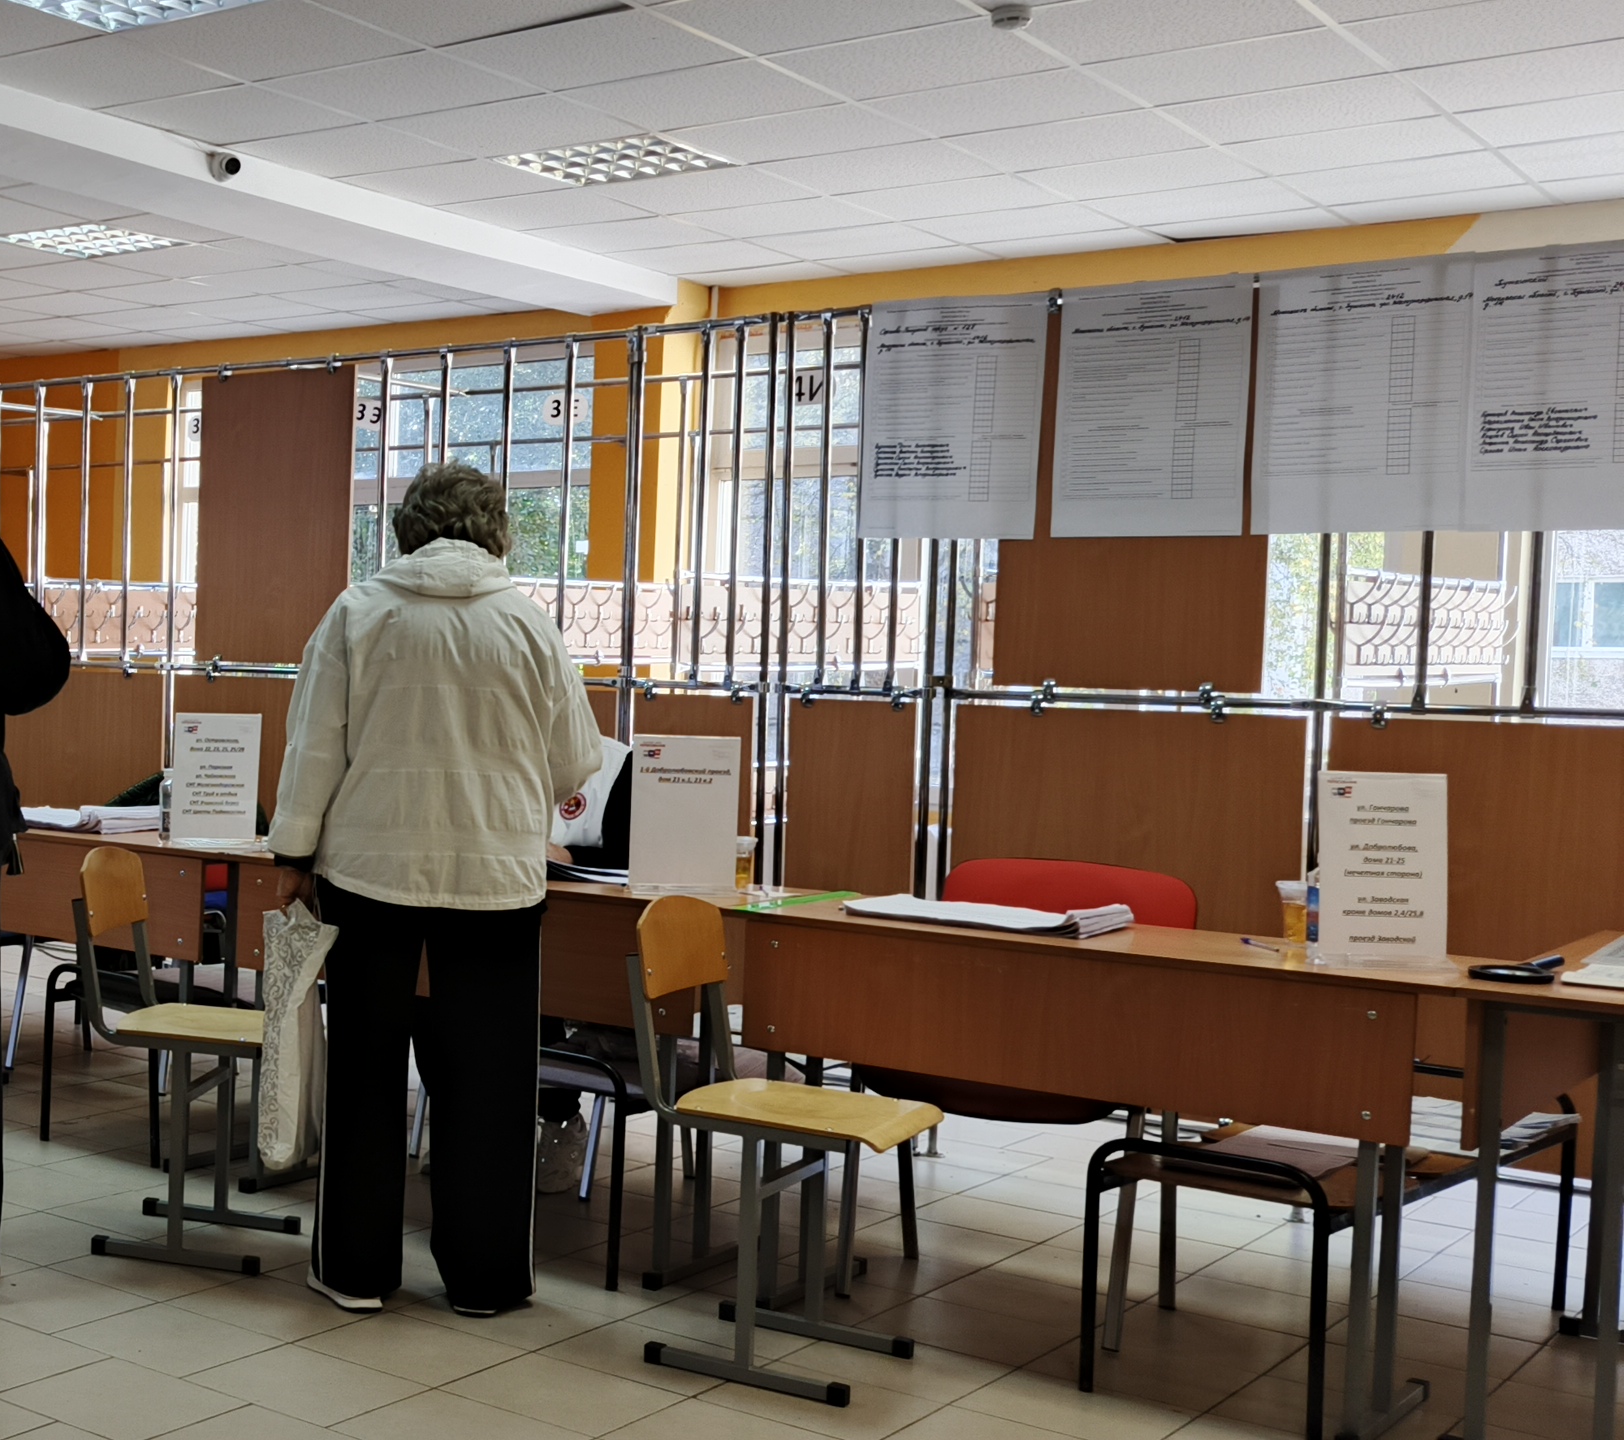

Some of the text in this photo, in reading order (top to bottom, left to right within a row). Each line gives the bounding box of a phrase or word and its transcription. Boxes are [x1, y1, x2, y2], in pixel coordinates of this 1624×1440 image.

[1368, 804, 1409, 813] Гончарова
[1349, 817, 1417, 827] проезд Гончарова
[1362, 843, 1418, 853] Добролюбова,
[1386, 870, 1423, 879] сторона)
[1349, 935, 1375, 943] проезд
